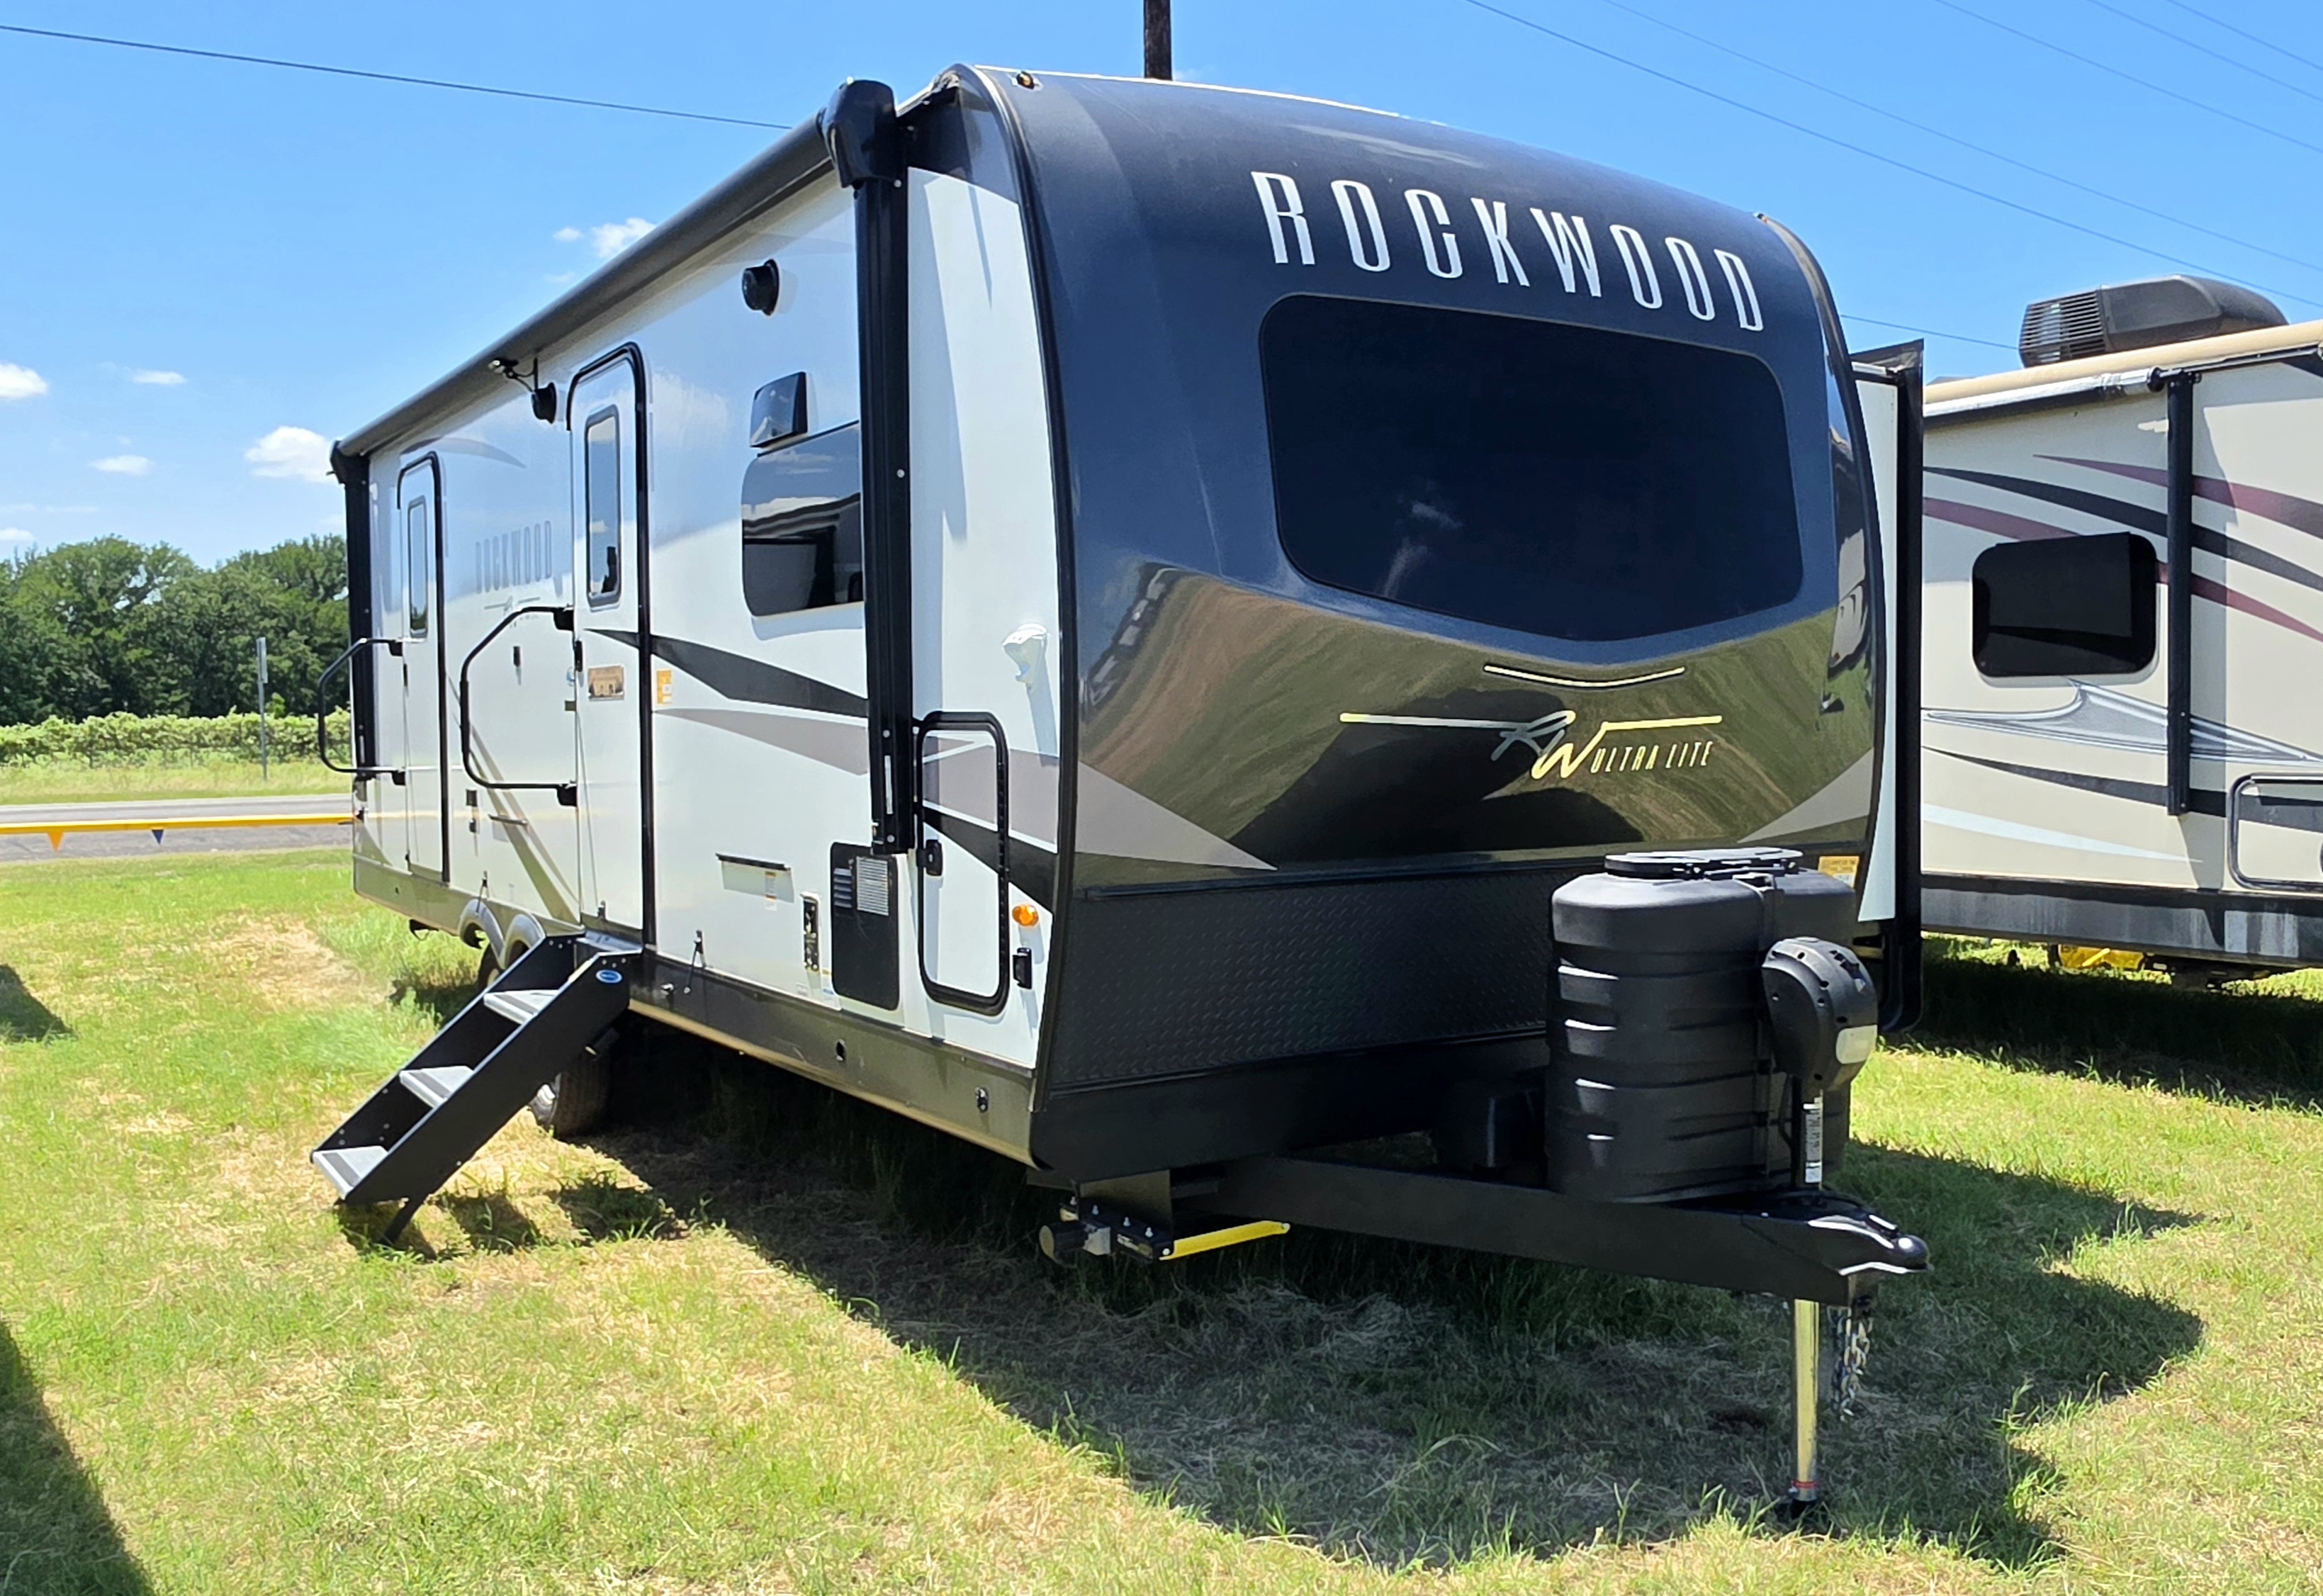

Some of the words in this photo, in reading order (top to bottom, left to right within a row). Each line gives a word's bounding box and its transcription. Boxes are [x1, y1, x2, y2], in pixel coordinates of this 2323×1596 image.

[1251, 172, 1764, 332] ROCKWOOD
[1591, 746, 1659, 773] ULTRA
[1665, 741, 1714, 769] LITE
